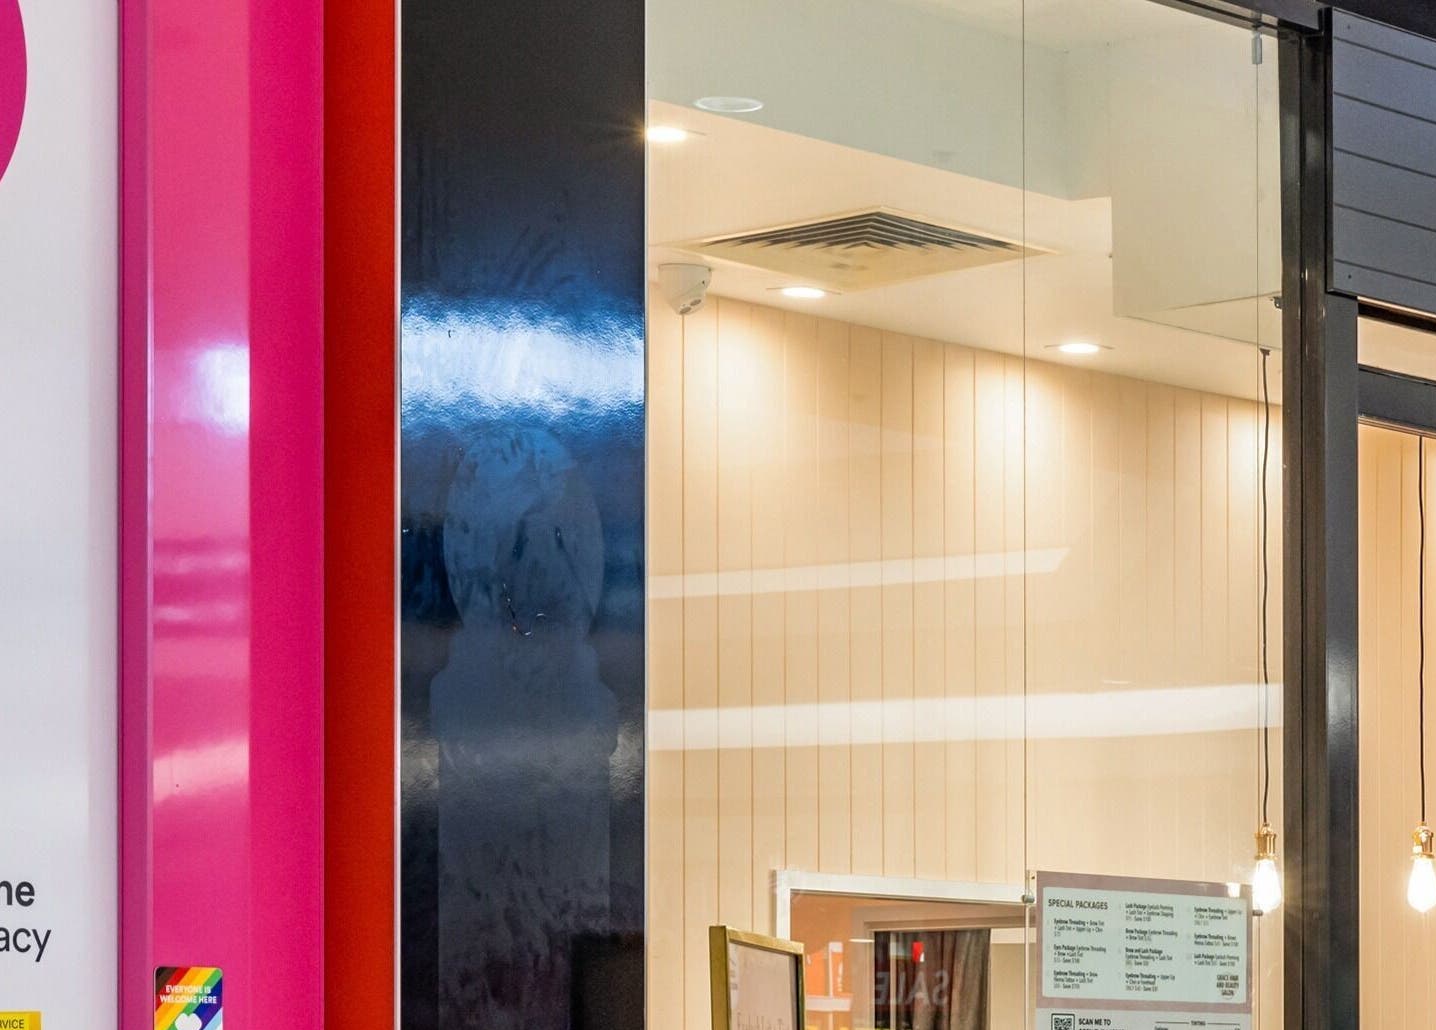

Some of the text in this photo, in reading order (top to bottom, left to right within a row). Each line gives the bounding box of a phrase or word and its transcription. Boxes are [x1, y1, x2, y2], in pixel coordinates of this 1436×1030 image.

[1048, 899, 1108, 910] SPECIAL PACKAGES
[165, 985, 212, 994] EVERYONE IS
[160, 994, 217, 1004] WELCOME HERE
[1078, 1018, 1112, 1026] SCAN ME TO
